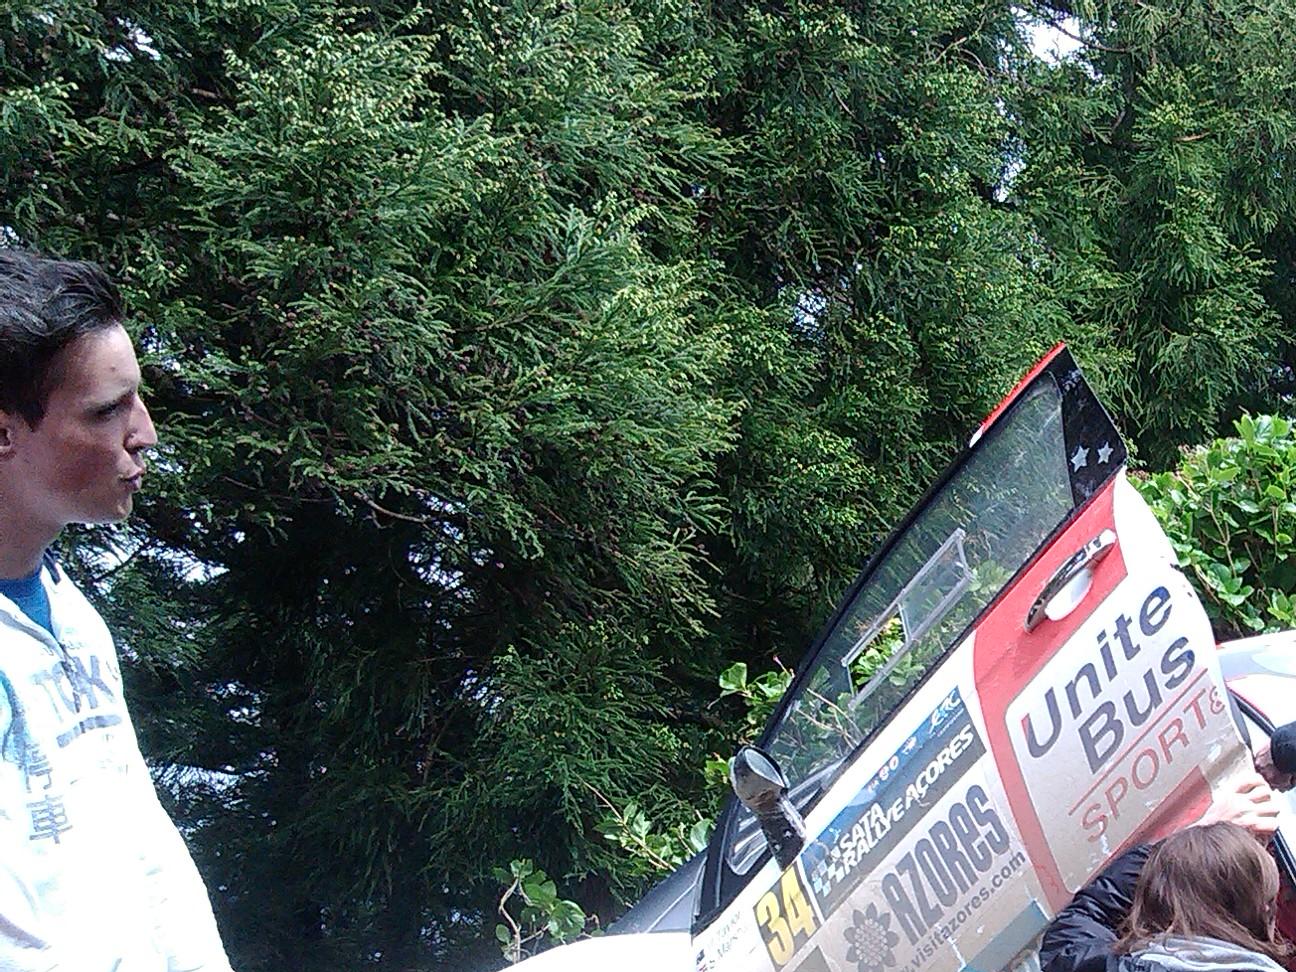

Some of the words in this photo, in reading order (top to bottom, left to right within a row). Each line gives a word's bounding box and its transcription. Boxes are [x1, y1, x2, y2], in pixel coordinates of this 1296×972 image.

[1021, 585, 1172, 758] Unite
[1078, 636, 1196, 775] Bus
[838, 802, 885, 846] SATA
[756, 864, 817, 966] 34
